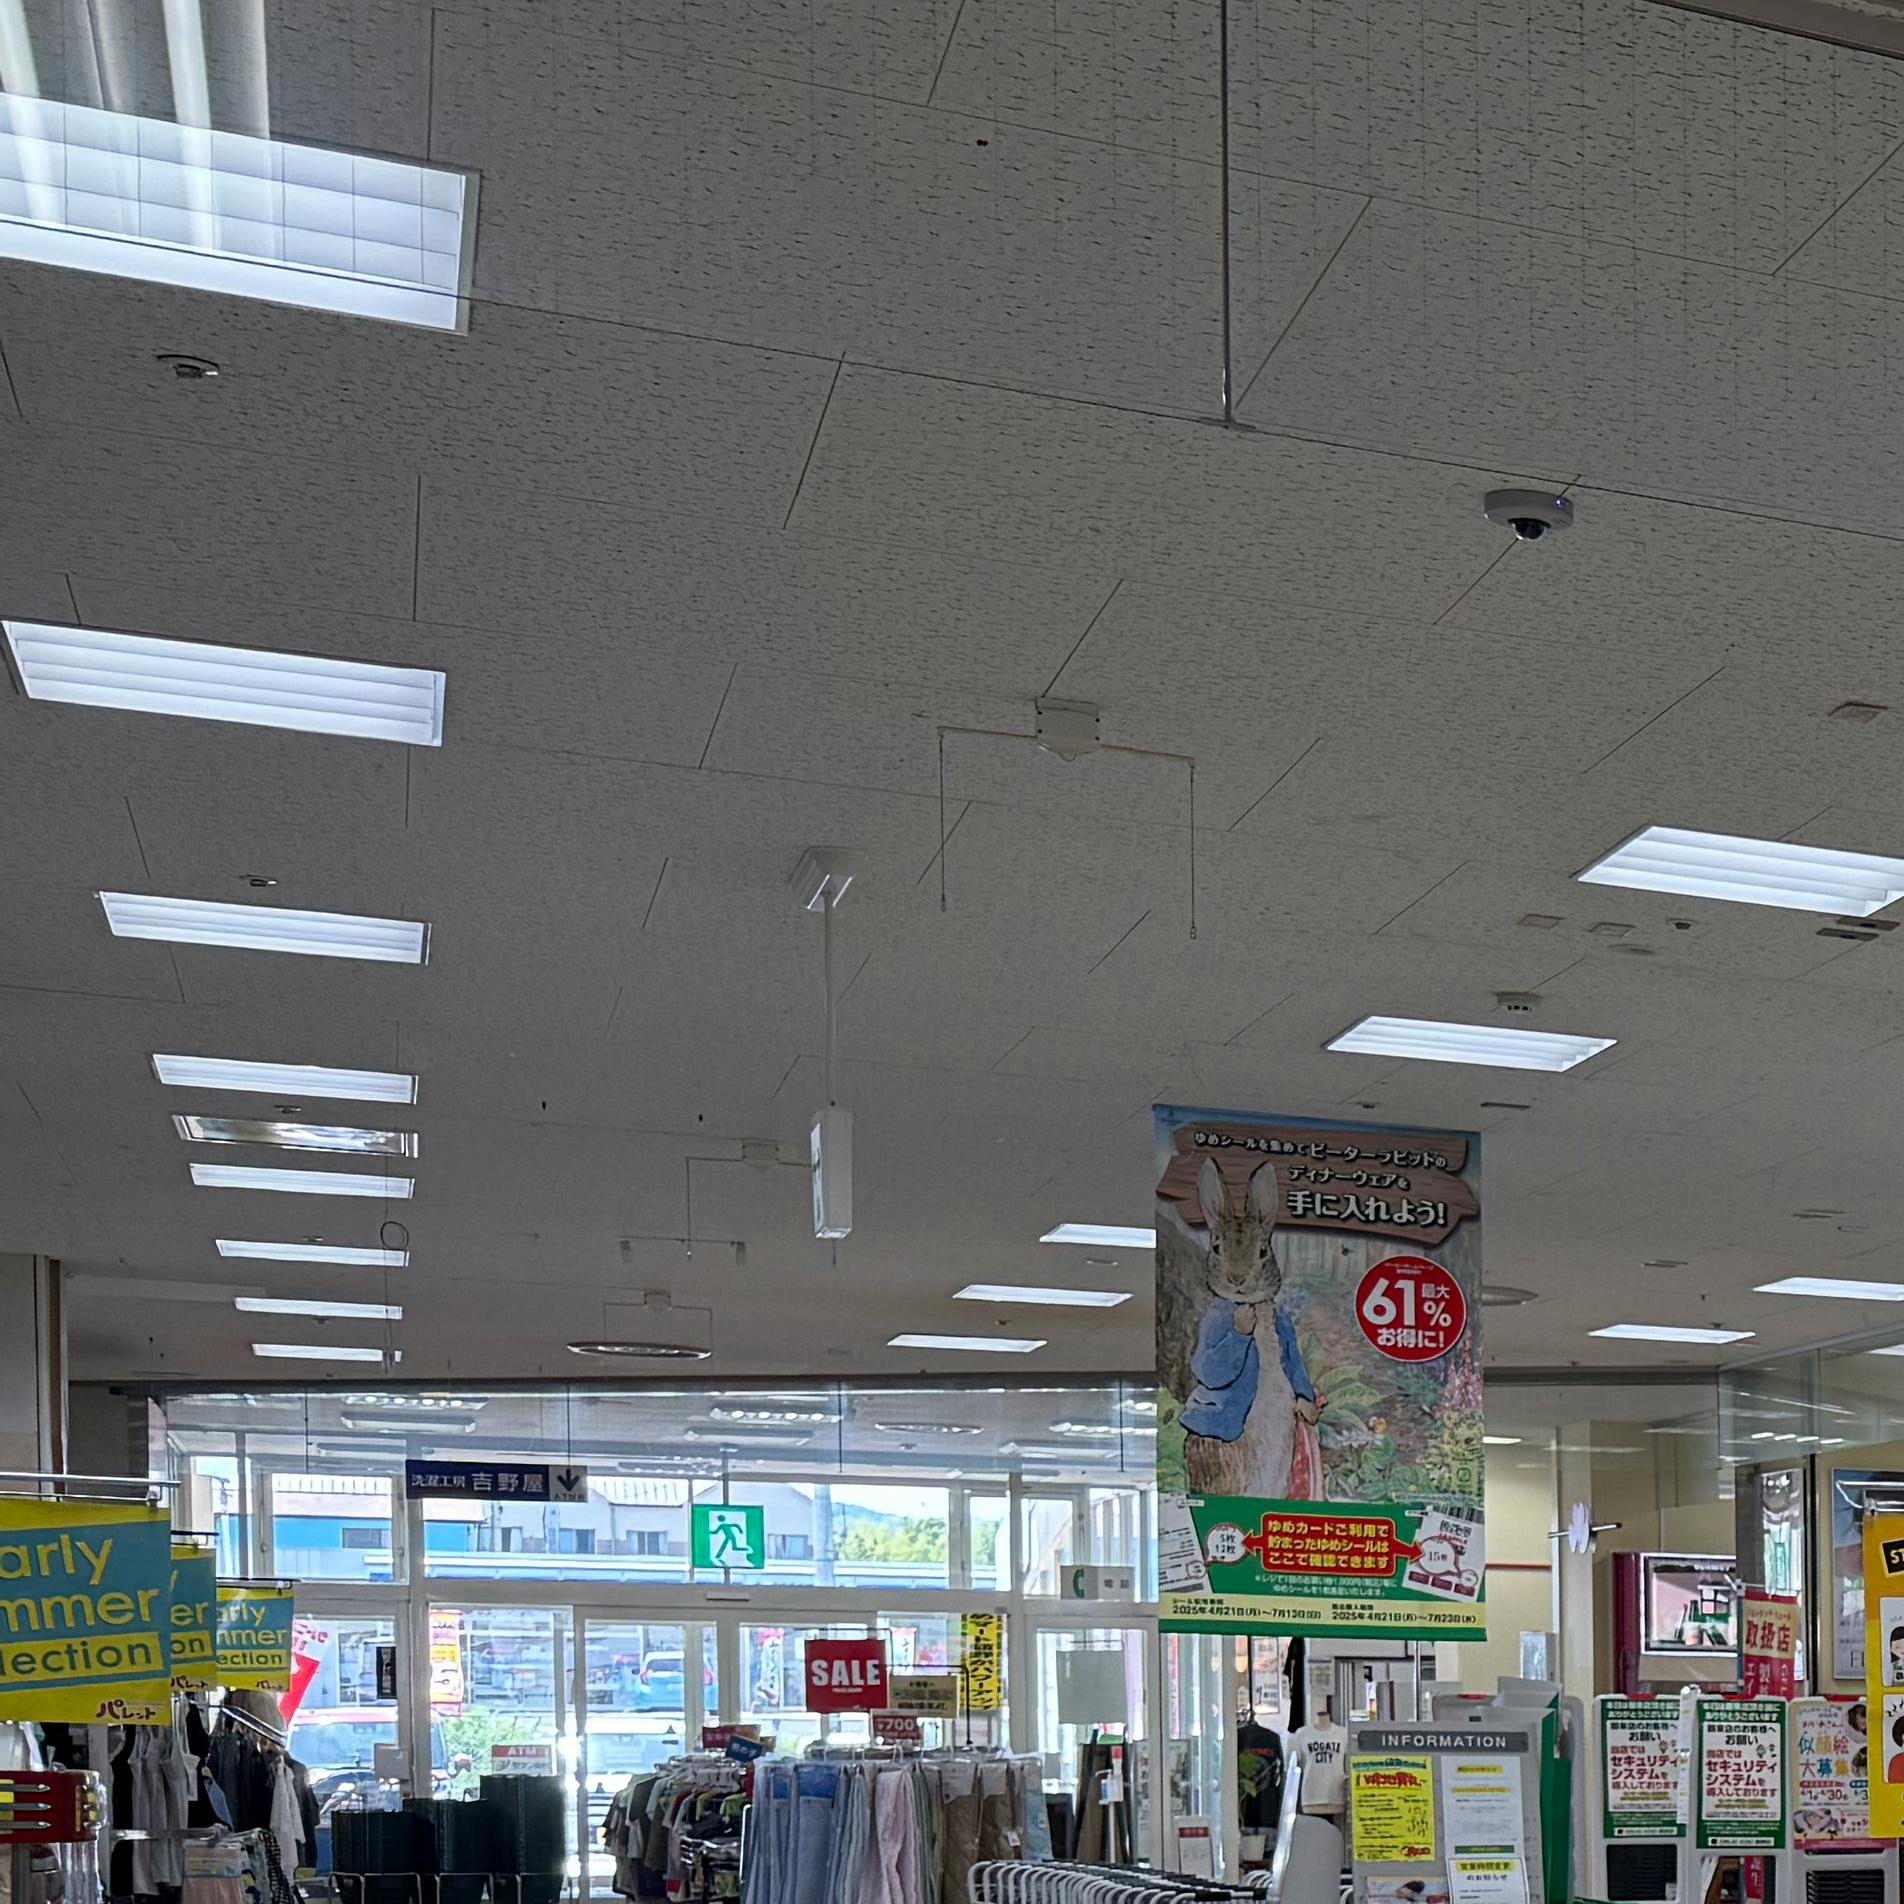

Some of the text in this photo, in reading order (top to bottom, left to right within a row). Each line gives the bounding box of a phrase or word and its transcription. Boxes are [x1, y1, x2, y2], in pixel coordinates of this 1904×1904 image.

[1288, 1165, 1410, 1190] ディナーウェアを
[1286, 1190, 1446, 1226] 手に入れよう!
[1377, 1328, 1445, 1349] お得に!
[471, 1471, 545, 1493] 吉野屋
[1267, 1519, 1390, 1538] ゆめカードご利用で
[1267, 1536, 1391, 1554] 貯まったゆめシールは
[0, 1533, 114, 1586] arly
[1267, 1552, 1390, 1570] ここで確認できます
[0, 1587, 160, 1634] mmer
[1745, 1619, 1791, 1653] 取扱店
[811, 1659, 881, 1687] SALE
[94, 1699, 157, 1722] パレット
[1381, 1734, 1508, 1748] INFORMATION
[1705, 1760, 1778, 1773] セキュリティ
[1799, 1757, 1850, 1778] 大募集
[1705, 1774, 1766, 1787] システムを
